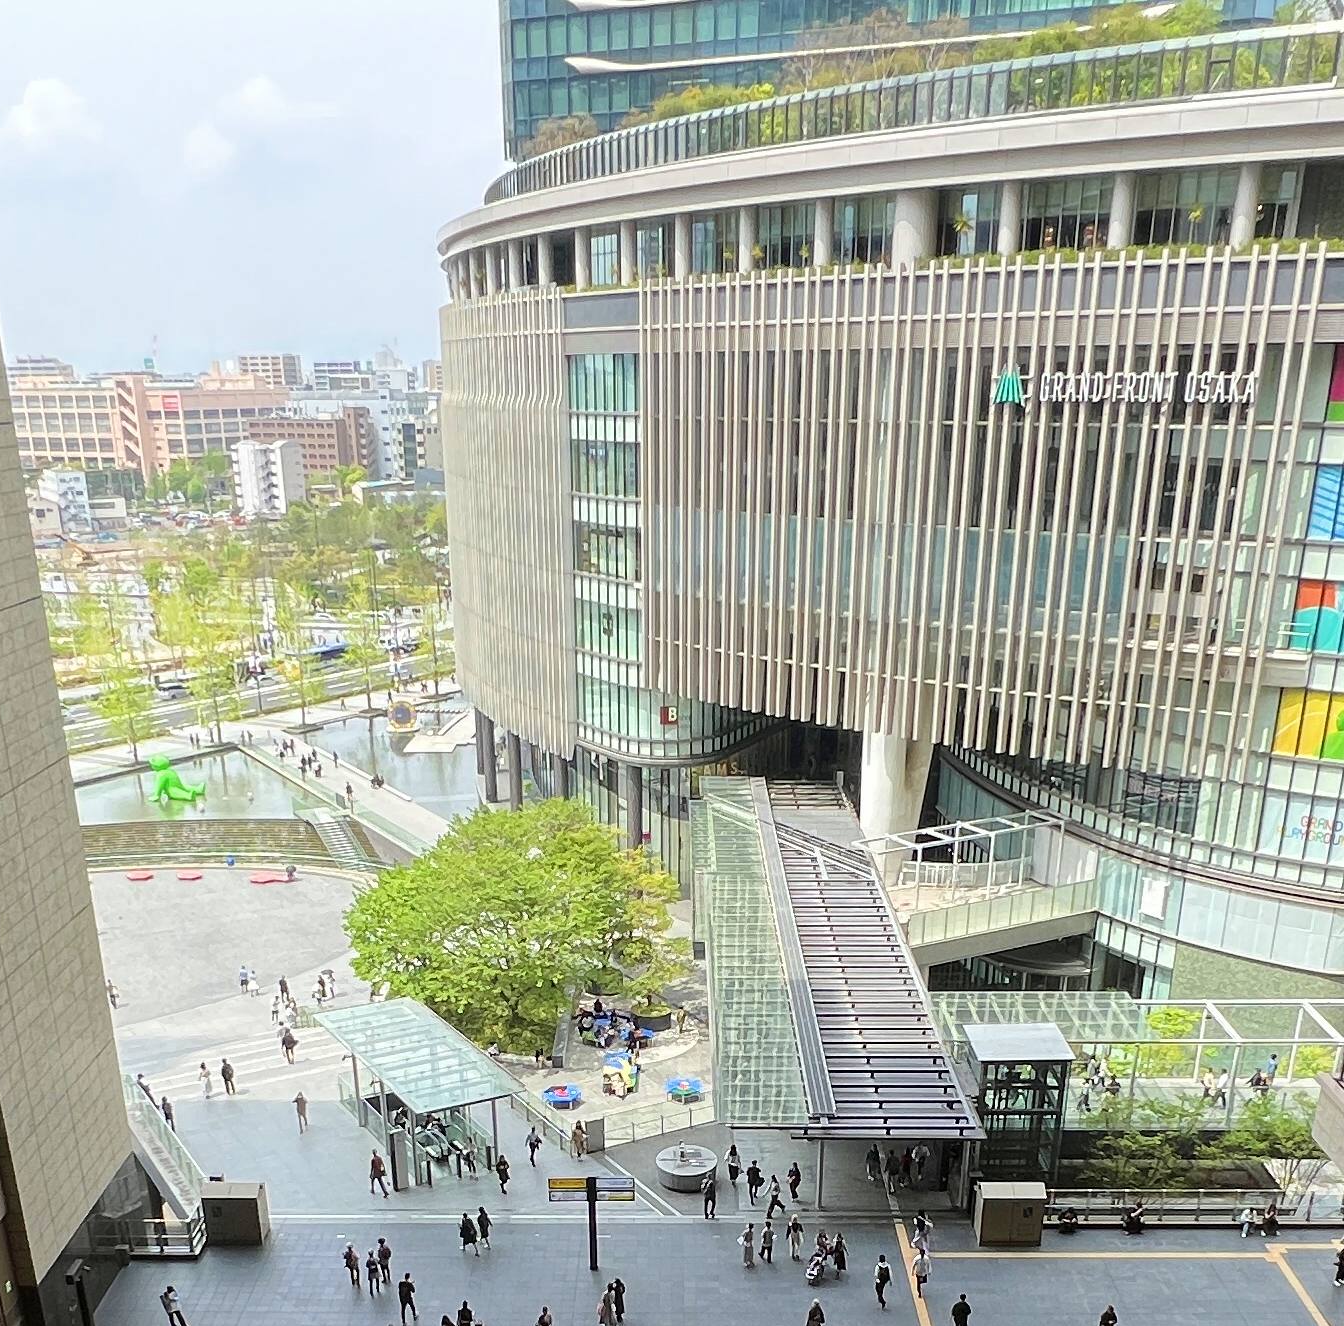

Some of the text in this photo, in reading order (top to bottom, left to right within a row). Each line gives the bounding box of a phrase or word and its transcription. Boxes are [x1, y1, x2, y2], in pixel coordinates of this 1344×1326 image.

[1039, 371, 1255, 404] GRAND FRONT OSAKA
